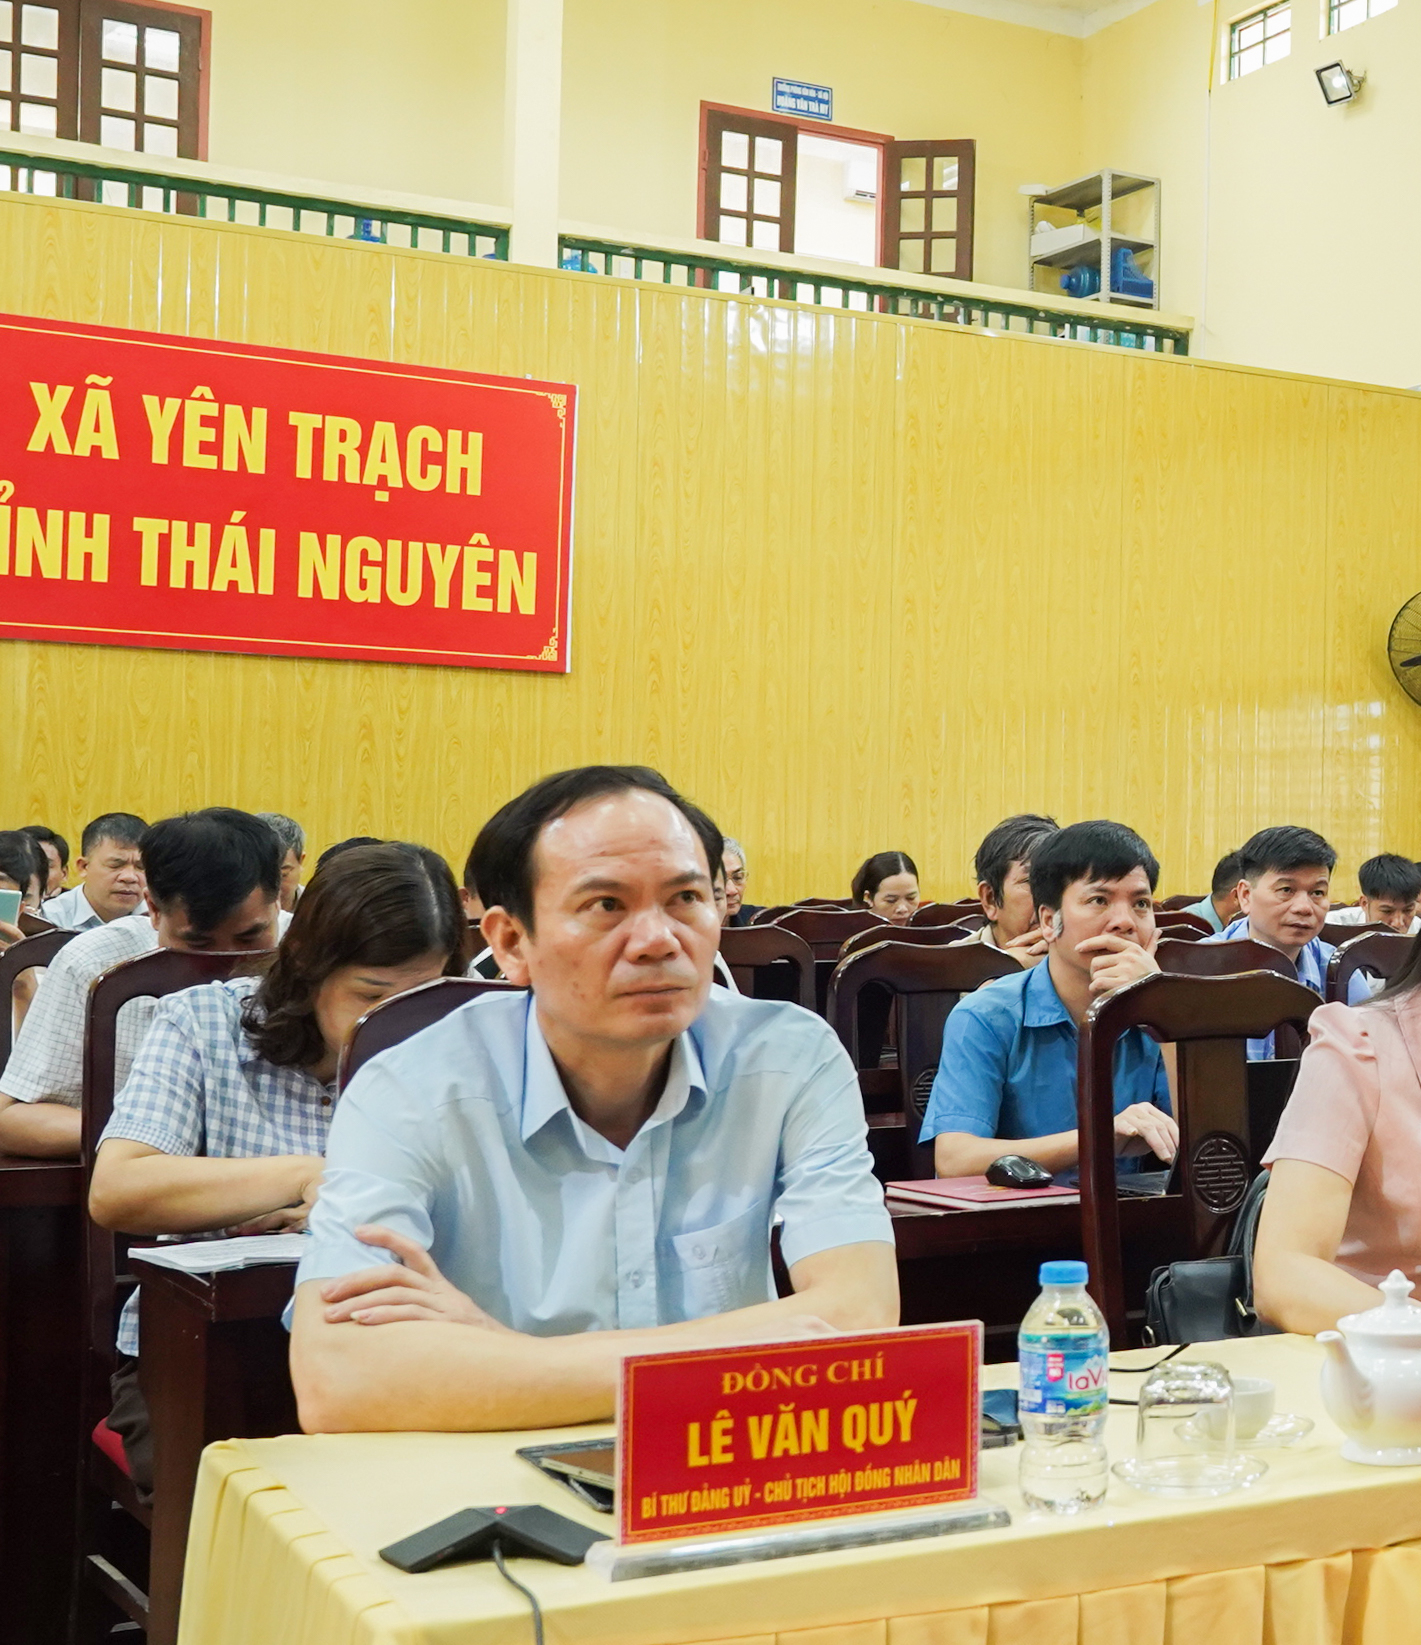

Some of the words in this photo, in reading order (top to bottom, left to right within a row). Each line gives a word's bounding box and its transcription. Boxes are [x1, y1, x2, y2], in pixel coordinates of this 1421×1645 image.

[26, 374, 119, 459] XÃ
[142, 386, 268, 474] YÊN
[289, 411, 484, 502] TRẠCH
[133, 511, 276, 595] THÁI
[298, 532, 538, 615] NGUYÊN
[826, 1351, 884, 1384] CHÍ
[688, 1409, 734, 1468] LÊ
[748, 1402, 829, 1460] VĂN
[843, 1389, 918, 1454] QUÝ
[641, 1491, 658, 1519] BÍ
[660, 1489, 690, 1517] THƯ
[690, 1483, 731, 1513] ĐẢNG
[763, 1472, 793, 1504] CHỦ
[795, 1475, 826, 1503] TỊCH
[828, 1468, 852, 1499] HỘI
[894, 1459, 931, 1487] NHÂN
[933, 1455, 961, 1482] DÂN
